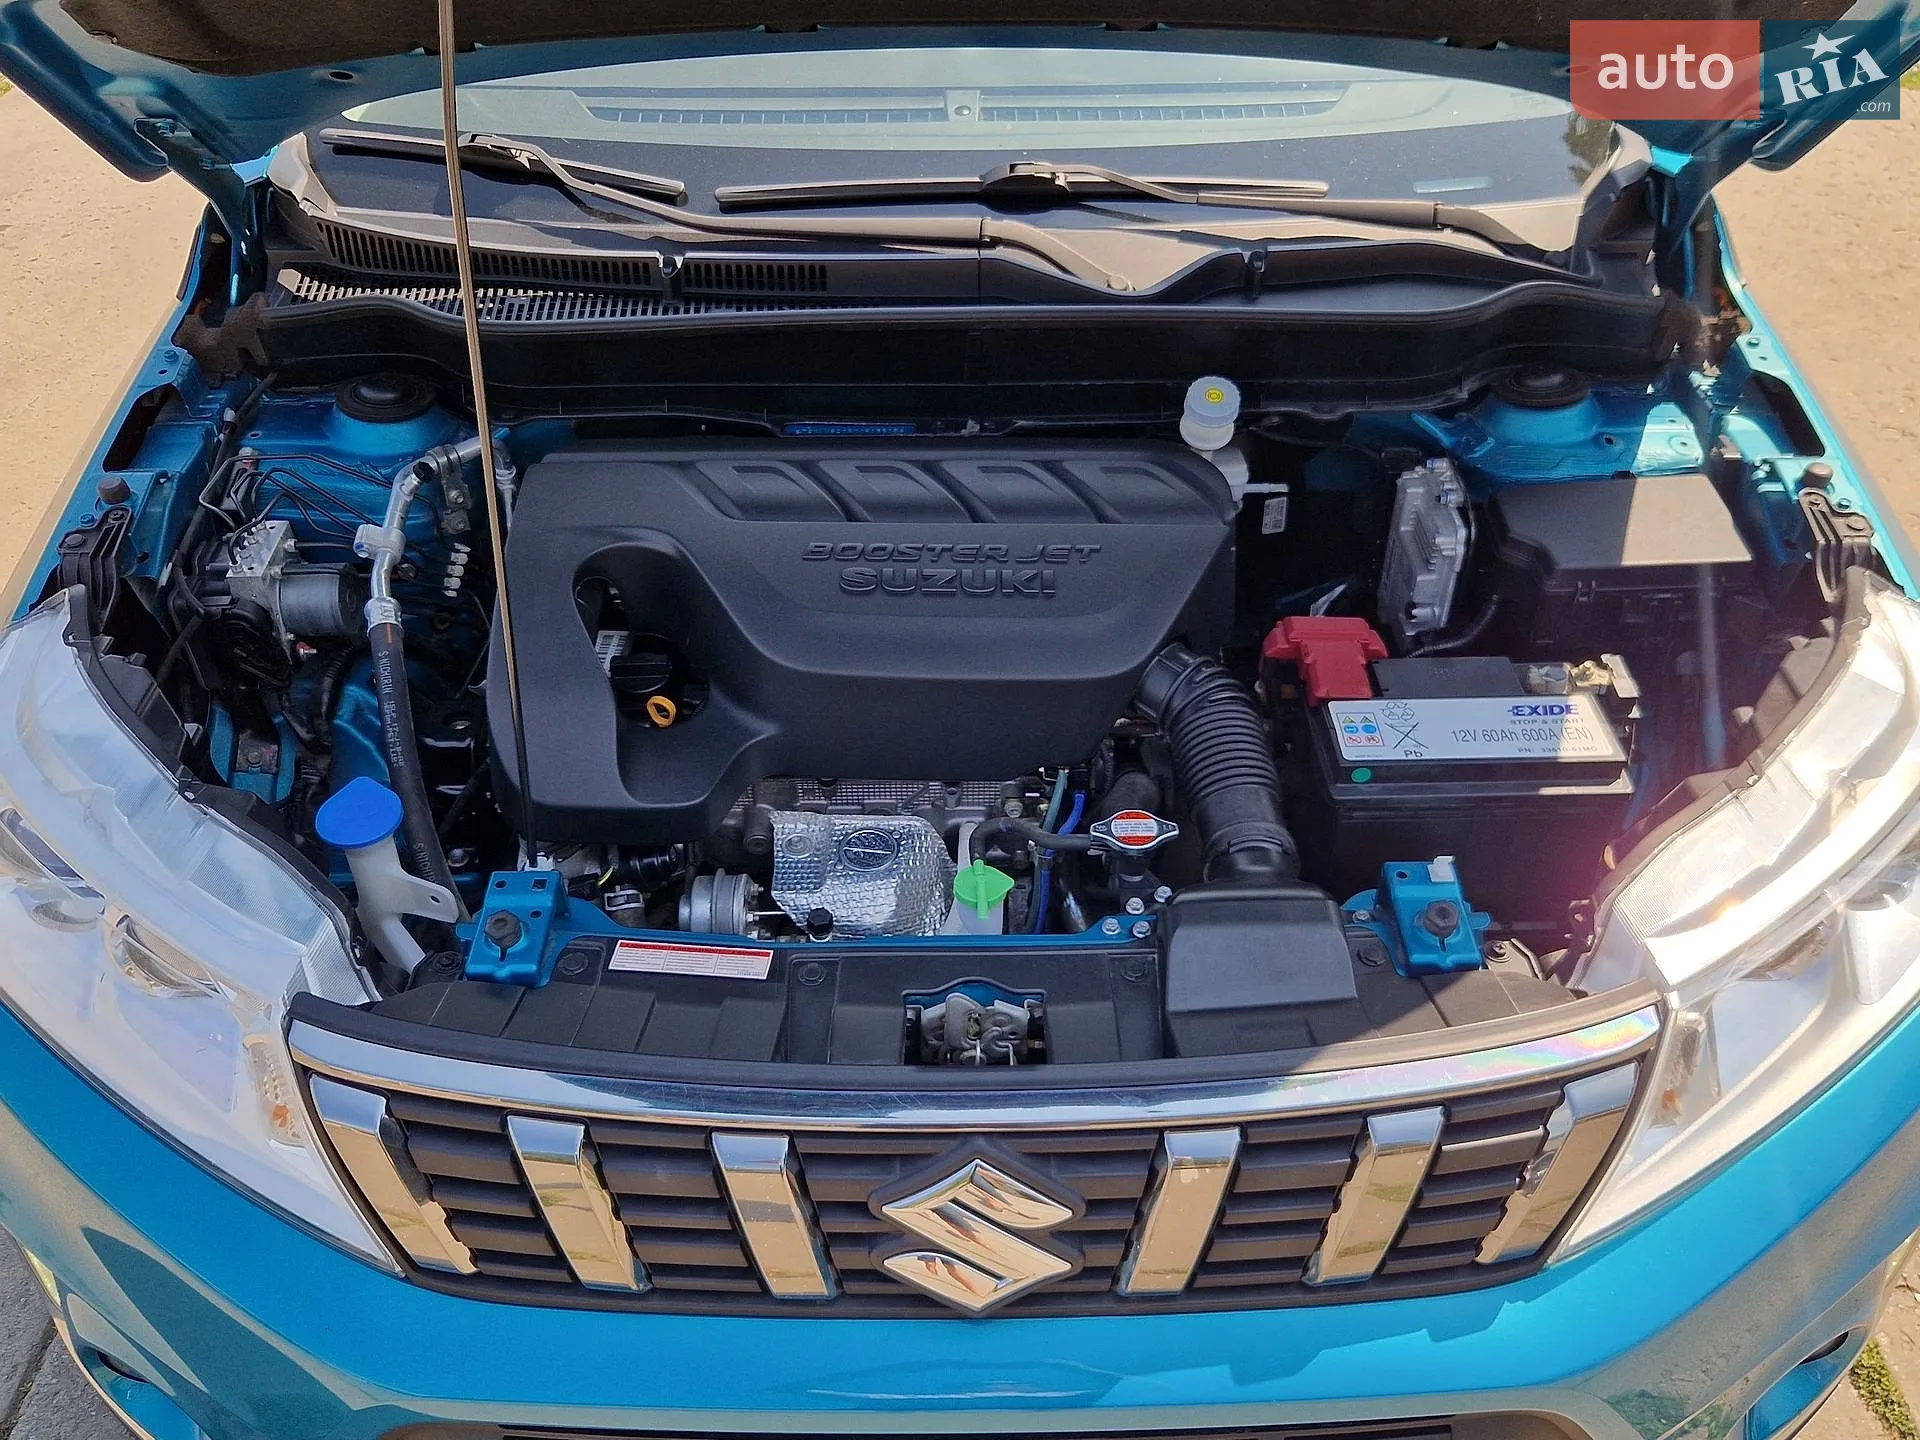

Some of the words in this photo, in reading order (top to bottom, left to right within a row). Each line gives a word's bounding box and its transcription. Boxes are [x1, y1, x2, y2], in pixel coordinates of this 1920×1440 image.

[801, 541, 1008, 563] BOOSTER
[1015, 543, 1102, 564] JET
[838, 566, 1057, 598] SUZUKI
[1508, 704, 1579, 717] EXIDE
[1451, 728, 1478, 743] 12V
[1482, 727, 1519, 743] 60Ah
[1522, 727, 1558, 743] 600A
[1560, 727, 1594, 744] (EN)
[1404, 749, 1423, 759] Pb
